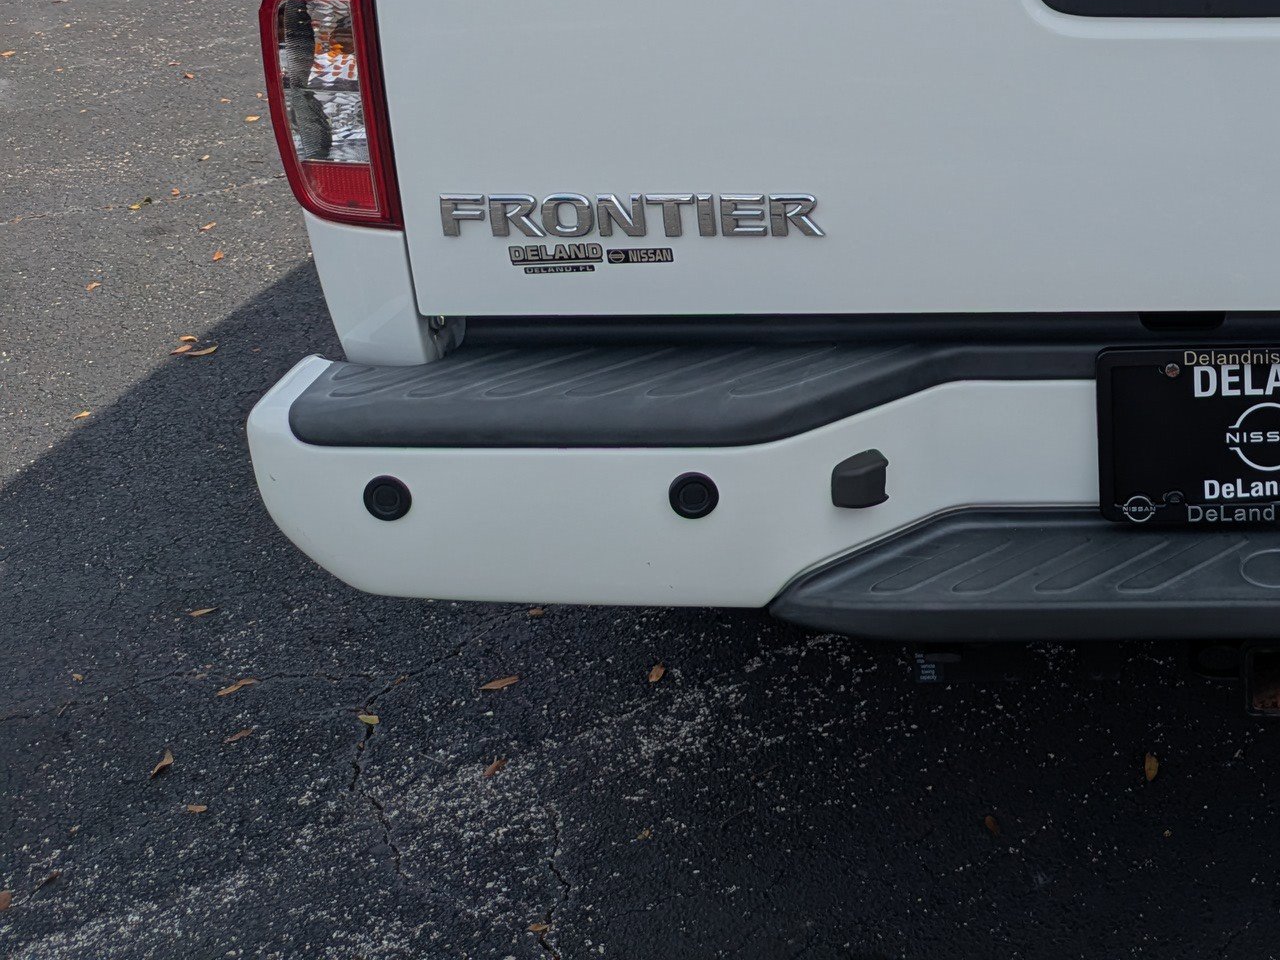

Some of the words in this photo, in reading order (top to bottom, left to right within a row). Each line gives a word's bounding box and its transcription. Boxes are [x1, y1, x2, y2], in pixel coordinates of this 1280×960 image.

[440, 192, 825, 238] FRONTIER
[509, 243, 603, 262] DELAND
[628, 249, 672, 262] NISSAN
[1187, 505, 1275, 523] DeLand
